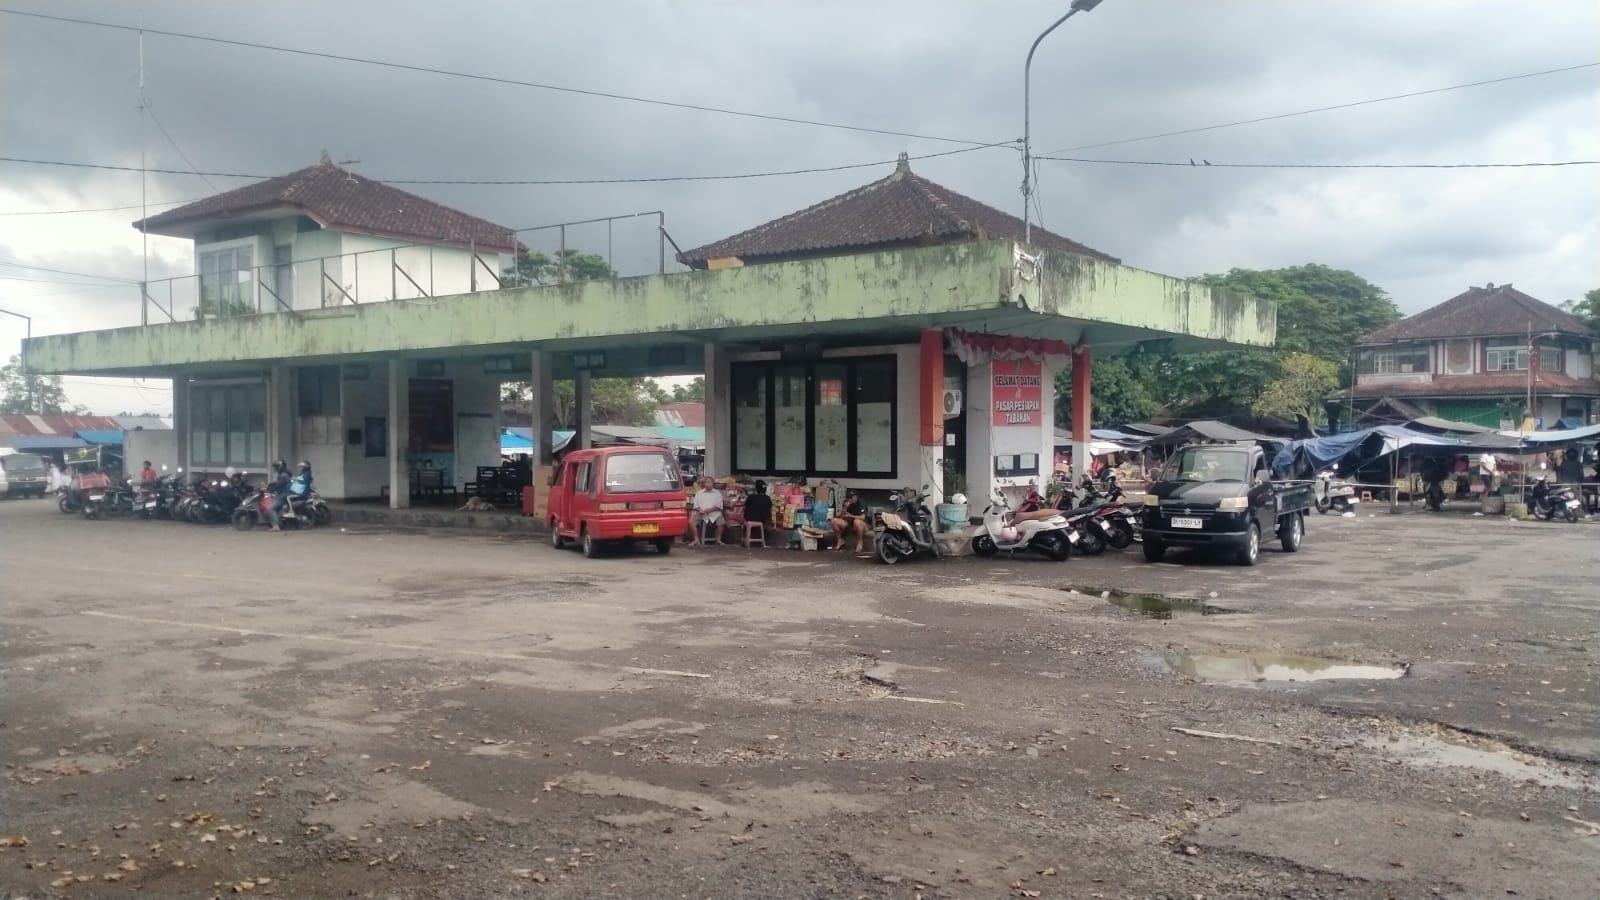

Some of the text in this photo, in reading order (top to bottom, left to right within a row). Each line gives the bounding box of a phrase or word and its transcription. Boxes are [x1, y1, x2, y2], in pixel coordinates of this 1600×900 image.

[994, 375, 1040, 387] SELAMAT DATANG
[996, 400, 1014, 412] PASAR
[1006, 412, 1031, 424] TABANAN
